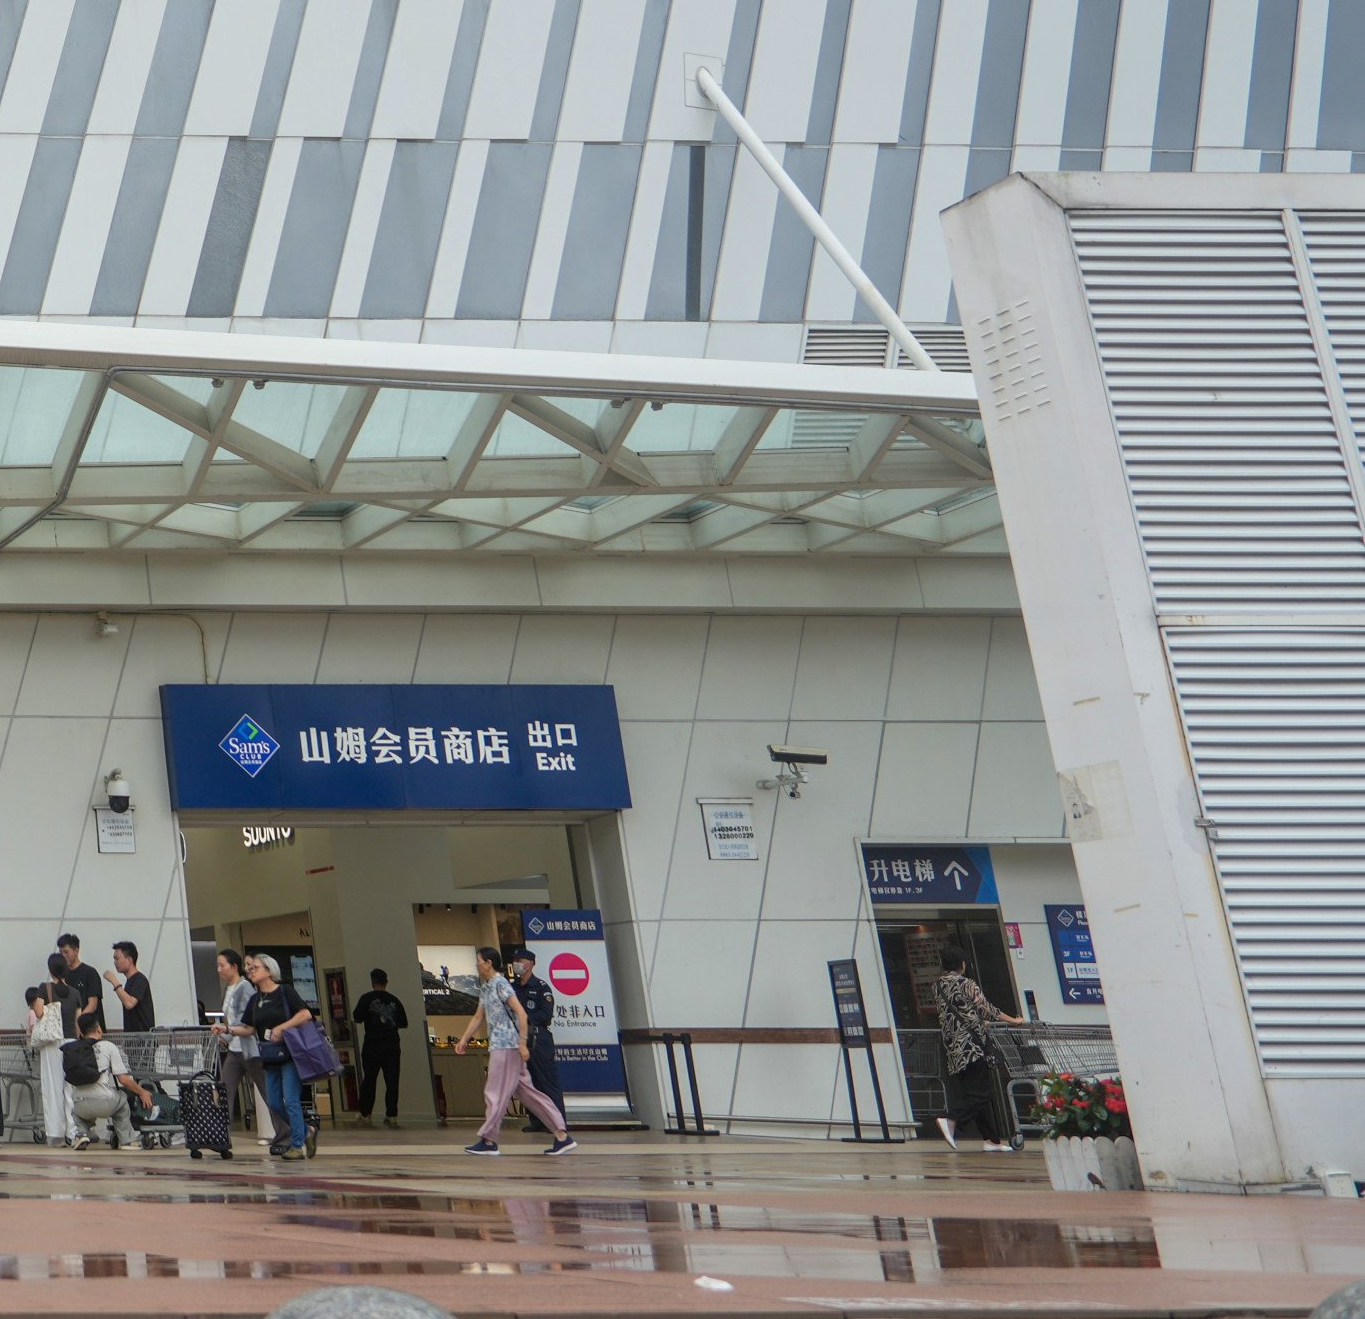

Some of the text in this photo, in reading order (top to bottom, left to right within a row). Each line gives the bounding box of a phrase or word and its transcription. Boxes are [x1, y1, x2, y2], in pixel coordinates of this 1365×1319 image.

[527, 720, 579, 748] 出口
[228, 737, 271, 754] Sam's
[299, 727, 511, 765] 山姆会员商店
[535, 751, 577, 771] Exit
[868, 859, 935, 882] 升电梯
[546, 921, 597, 931] 山姆会员商店
[554, 1004, 605, 1019] 处非入口
